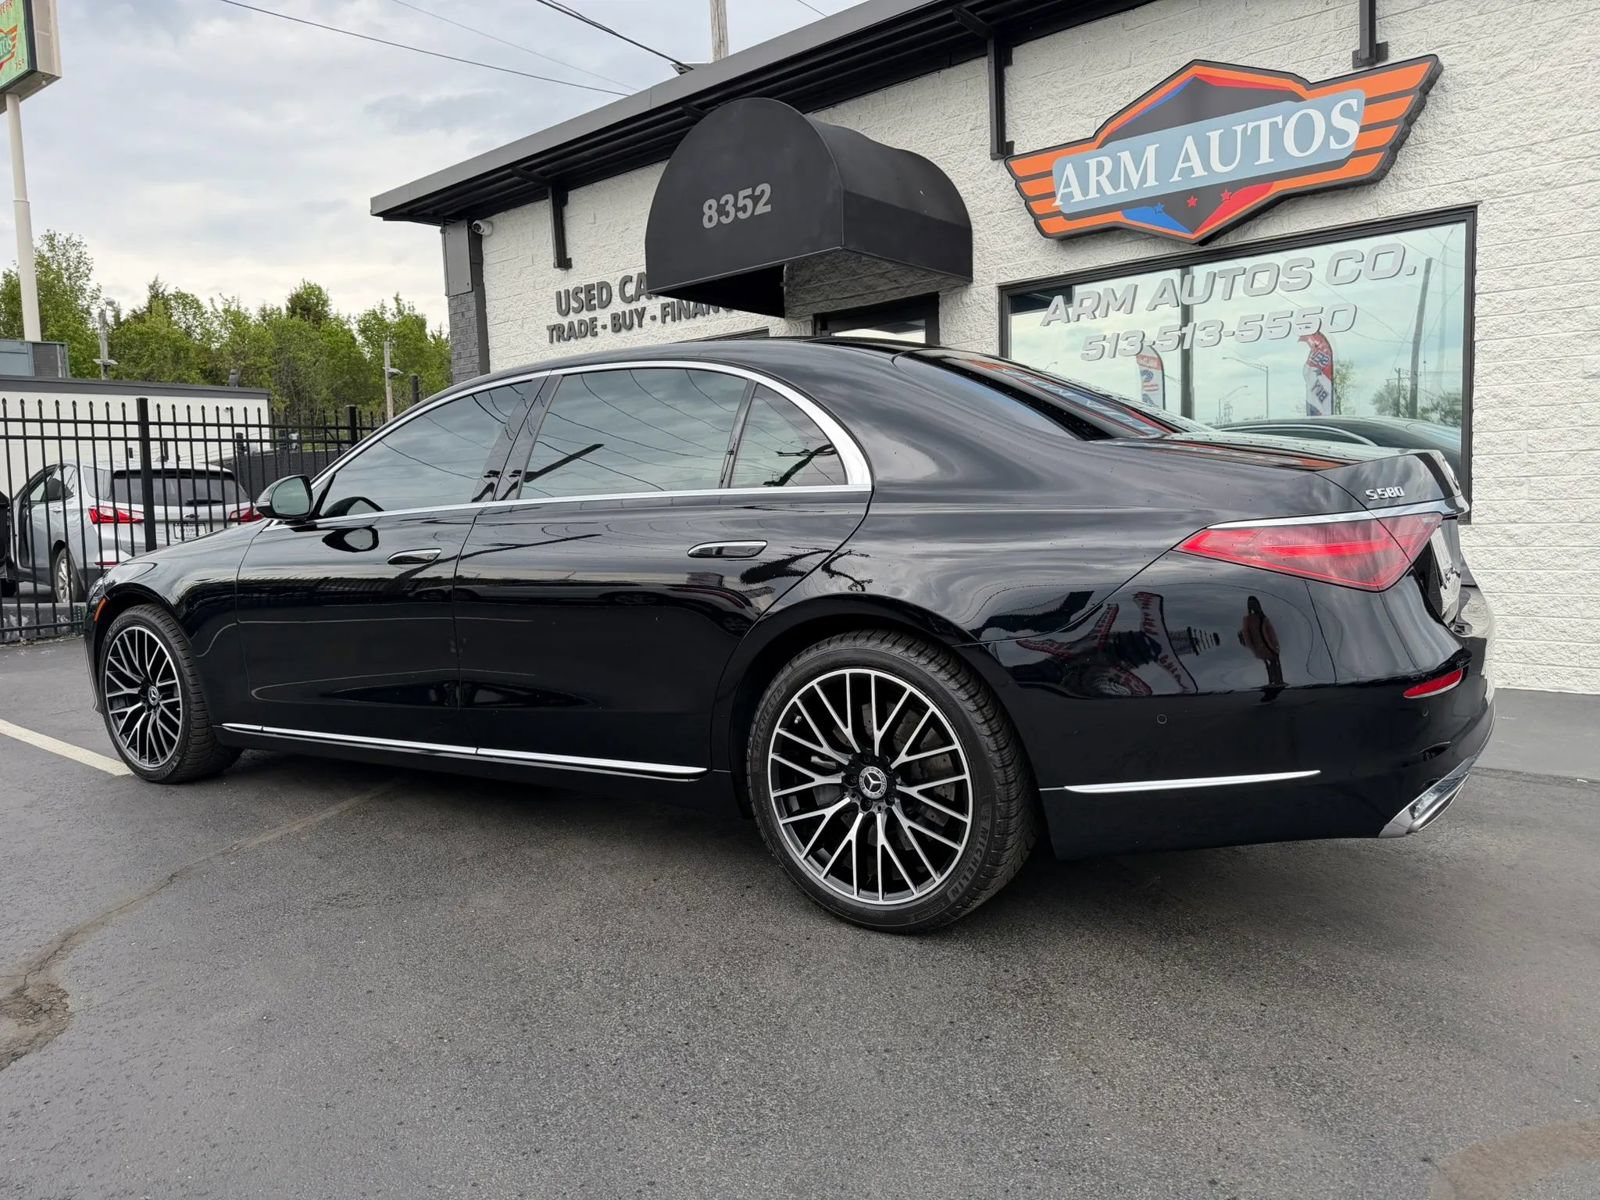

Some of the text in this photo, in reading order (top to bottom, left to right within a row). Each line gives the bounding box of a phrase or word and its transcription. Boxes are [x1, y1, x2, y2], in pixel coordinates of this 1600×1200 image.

[1052, 97, 1360, 206] ARM AUTOS
[702, 182, 772, 229] 8352
[555, 271, 659, 317] USED CA
[1040, 242, 1416, 327] ARM AUTOS CO.
[546, 316, 599, 344] TRADE
[610, 306, 647, 333] BUY
[1080, 302, 1358, 362] 513-513-5550
[947, 825, 989, 899] MICHELIN
